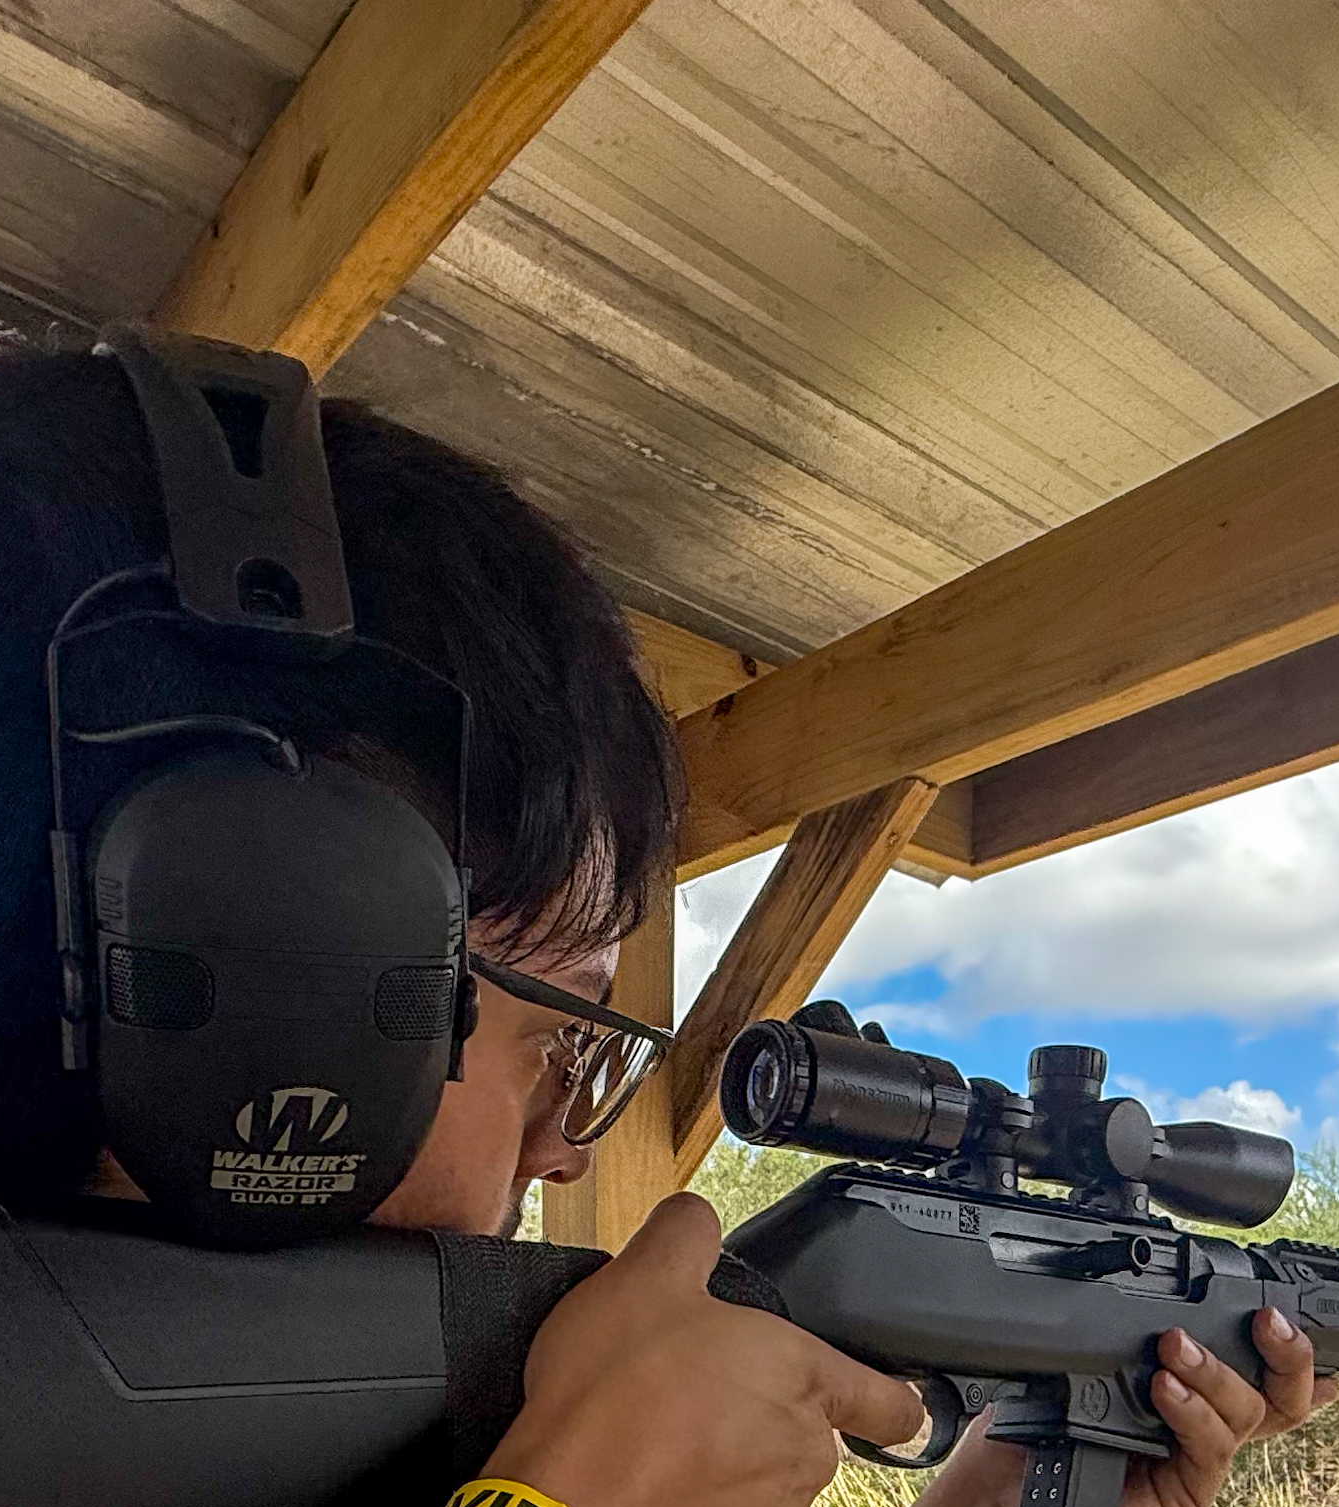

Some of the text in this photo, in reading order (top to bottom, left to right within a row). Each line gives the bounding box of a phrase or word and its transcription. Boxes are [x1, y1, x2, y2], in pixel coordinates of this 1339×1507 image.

[213, 1151, 358, 1172] WALKER'S
[231, 1174, 336, 1190] RAZOR
[231, 1192, 332, 1205] QUAD BT
